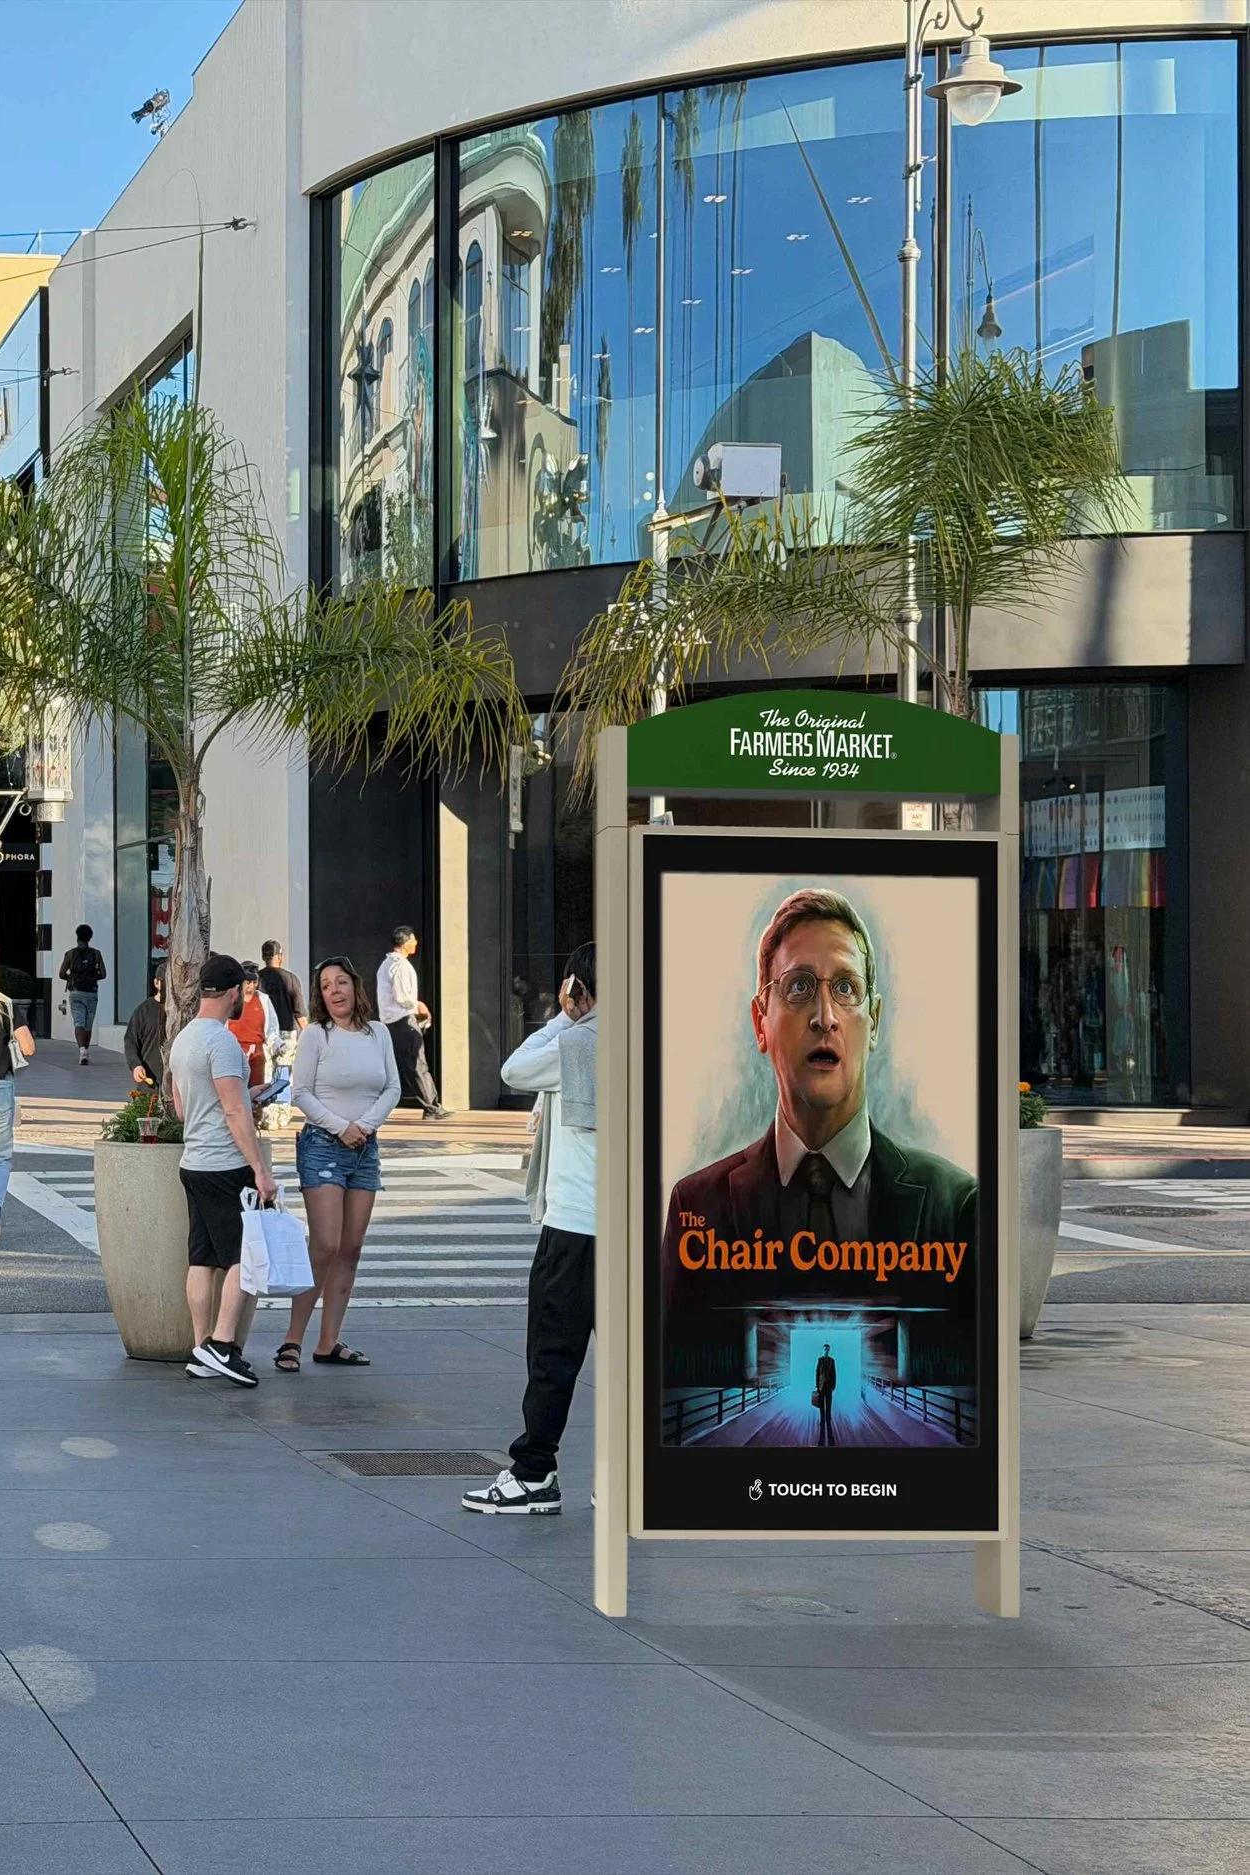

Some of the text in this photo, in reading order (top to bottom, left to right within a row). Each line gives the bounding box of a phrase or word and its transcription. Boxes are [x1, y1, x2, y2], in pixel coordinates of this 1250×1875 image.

[760, 709, 866, 734] The Original
[730, 728, 813, 757] FARMERS
[768, 758, 860, 779] Since 1934
[679, 1211, 706, 1227] The
[679, 1228, 968, 1284] Chair Company
[768, 1483, 897, 1497] TOUCH TO BEGIN
